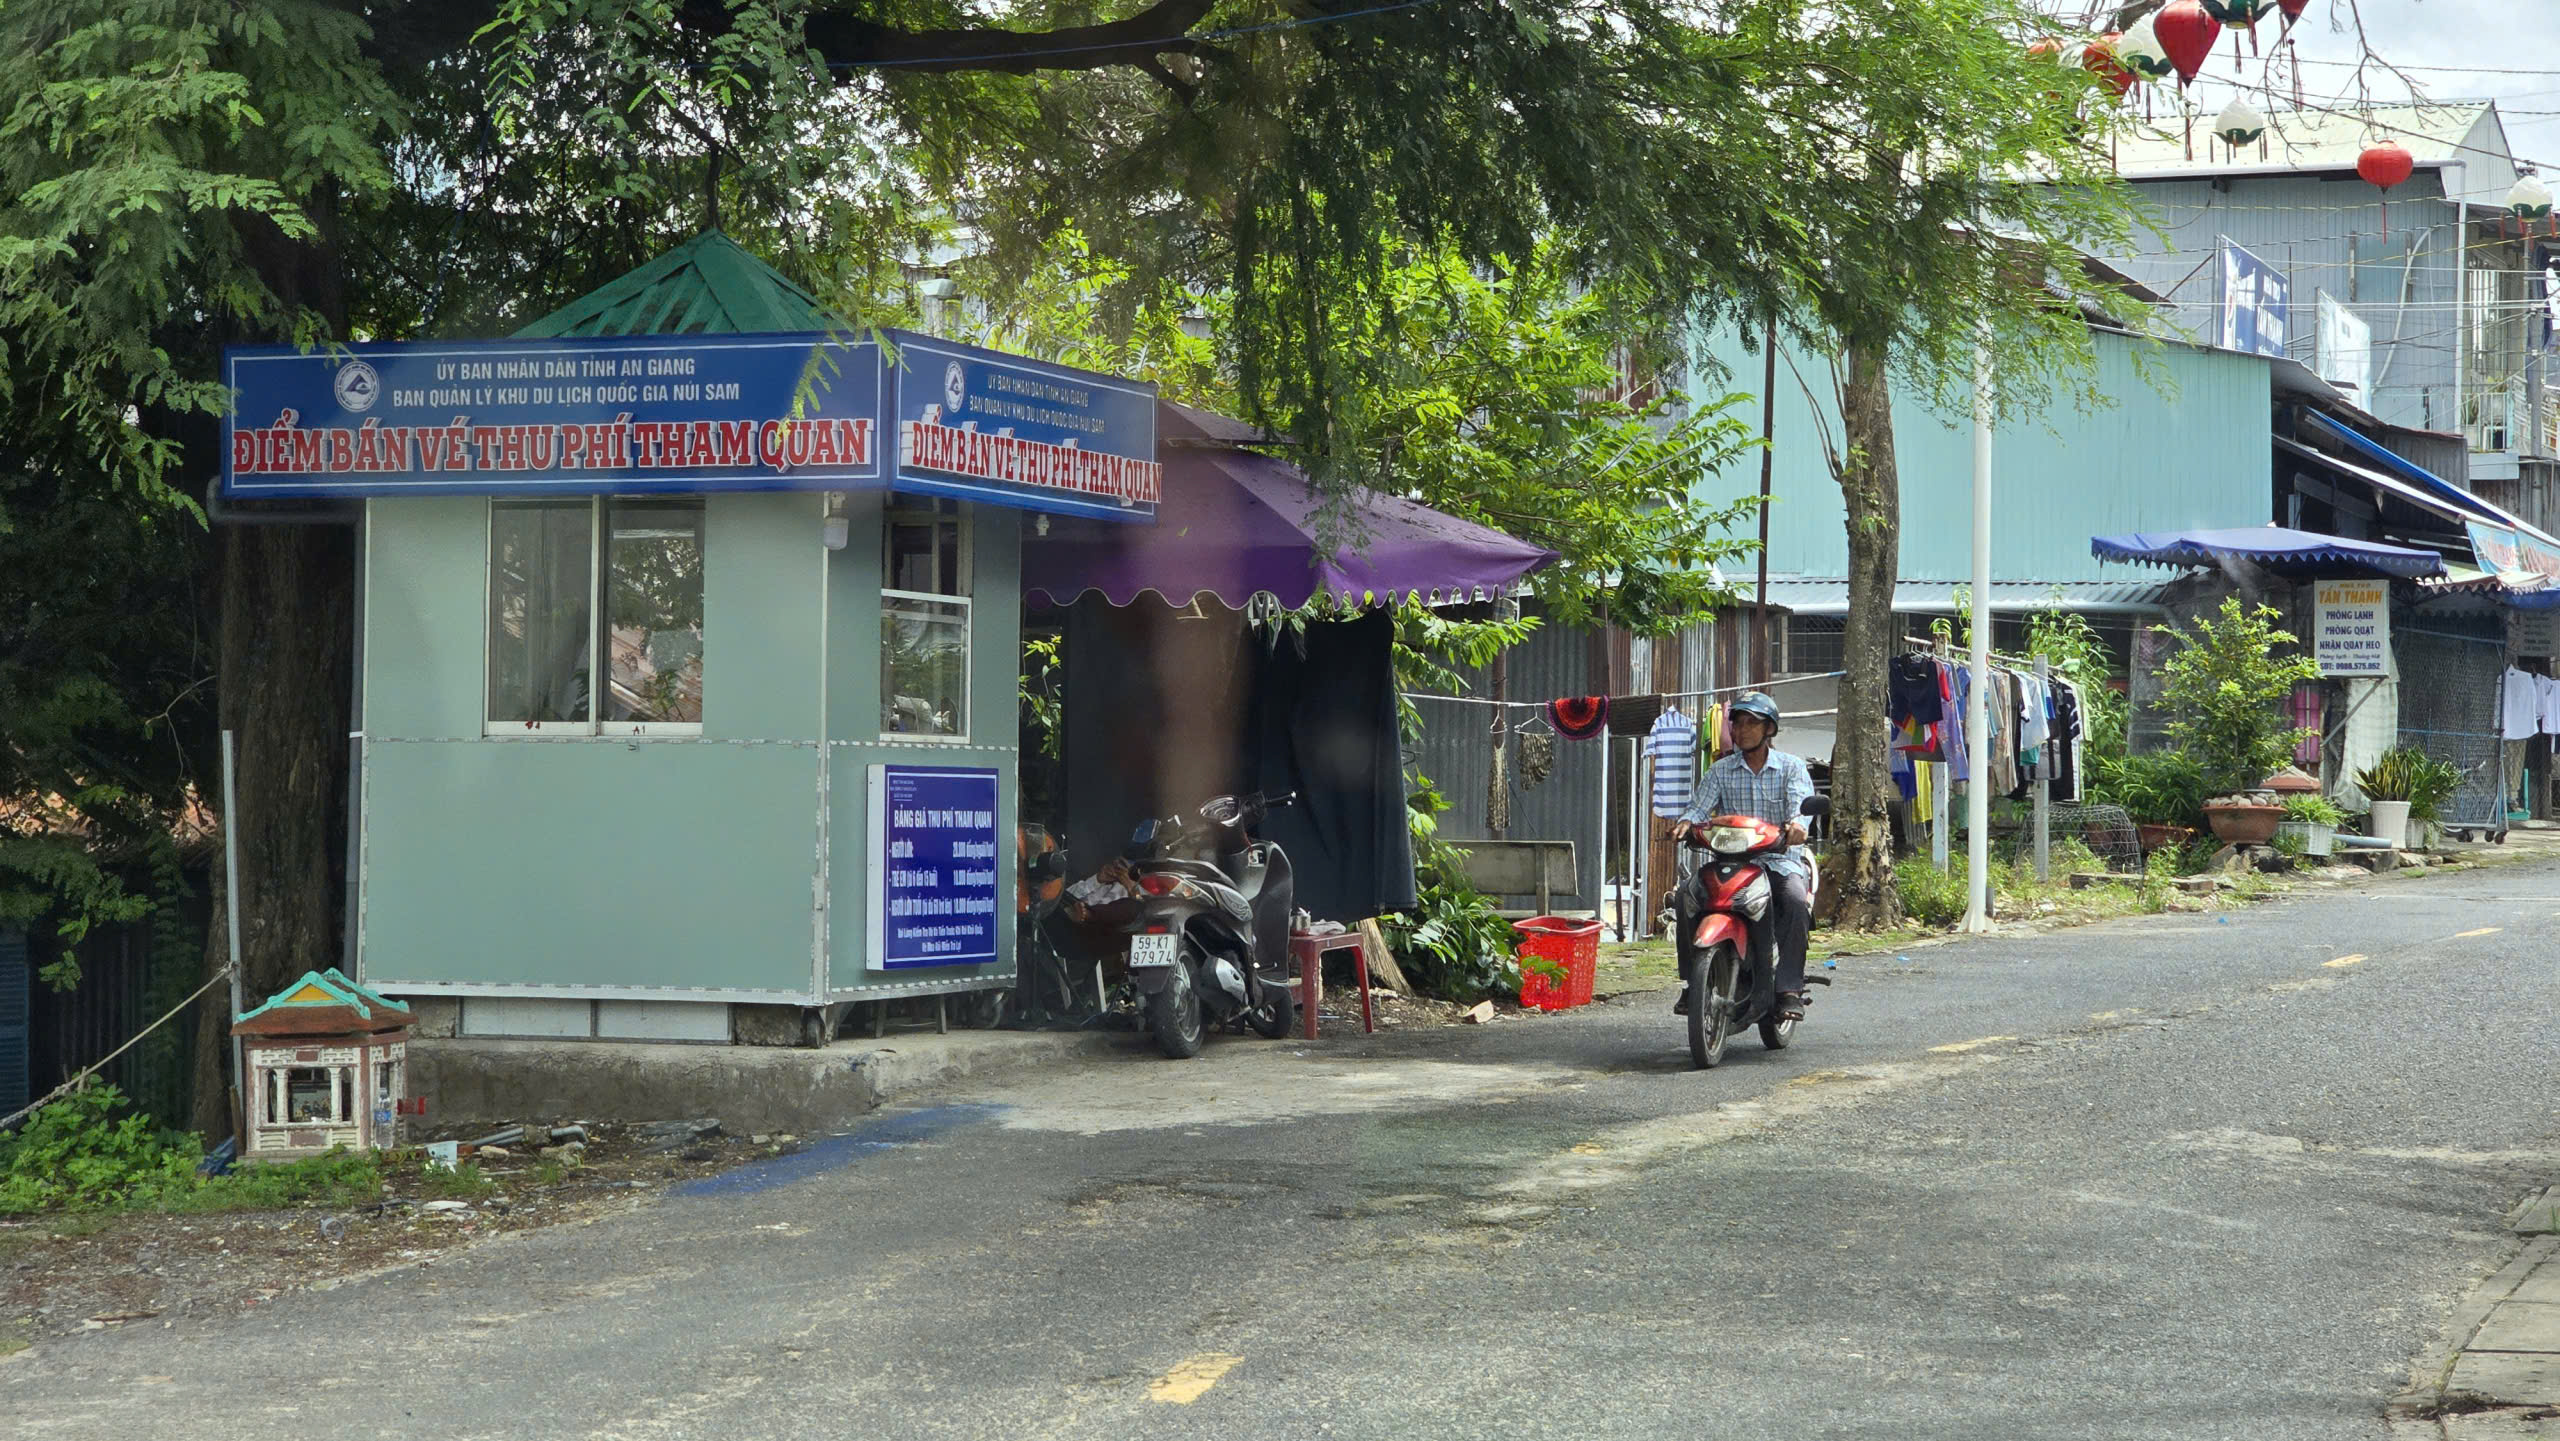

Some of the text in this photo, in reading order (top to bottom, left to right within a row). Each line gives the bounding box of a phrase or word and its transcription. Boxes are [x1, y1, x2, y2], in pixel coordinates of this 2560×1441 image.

[461, 362, 492, 380] BAN
[497, 358, 539, 379] NHÂN
[544, 358, 576, 378] DÂN
[581, 355, 616, 377] TỈNH
[620, 359, 642, 377] AN
[647, 358, 695, 376] GIANG
[393, 379, 739, 408] BAN QUẢN LÝ KHU DU LỊCH QUỐC GIA NÚI SAM
[233, 408, 872, 473] ĐIỂM BÁN VÉ THU PHÍ THAM QUAN
[912, 404, 1162, 503] ĐIỂM BÁN VÉ THU PHÍ THAM QUAN
[2326, 609, 2352, 620] PHÒNG
[2325, 624, 2352, 635] PHÒNG
[928, 810, 940, 828] THU
[942, 806, 954, 828] PHÍ
[955, 810, 973, 829] THAM
[1133, 950, 1172, 965] 979.74
